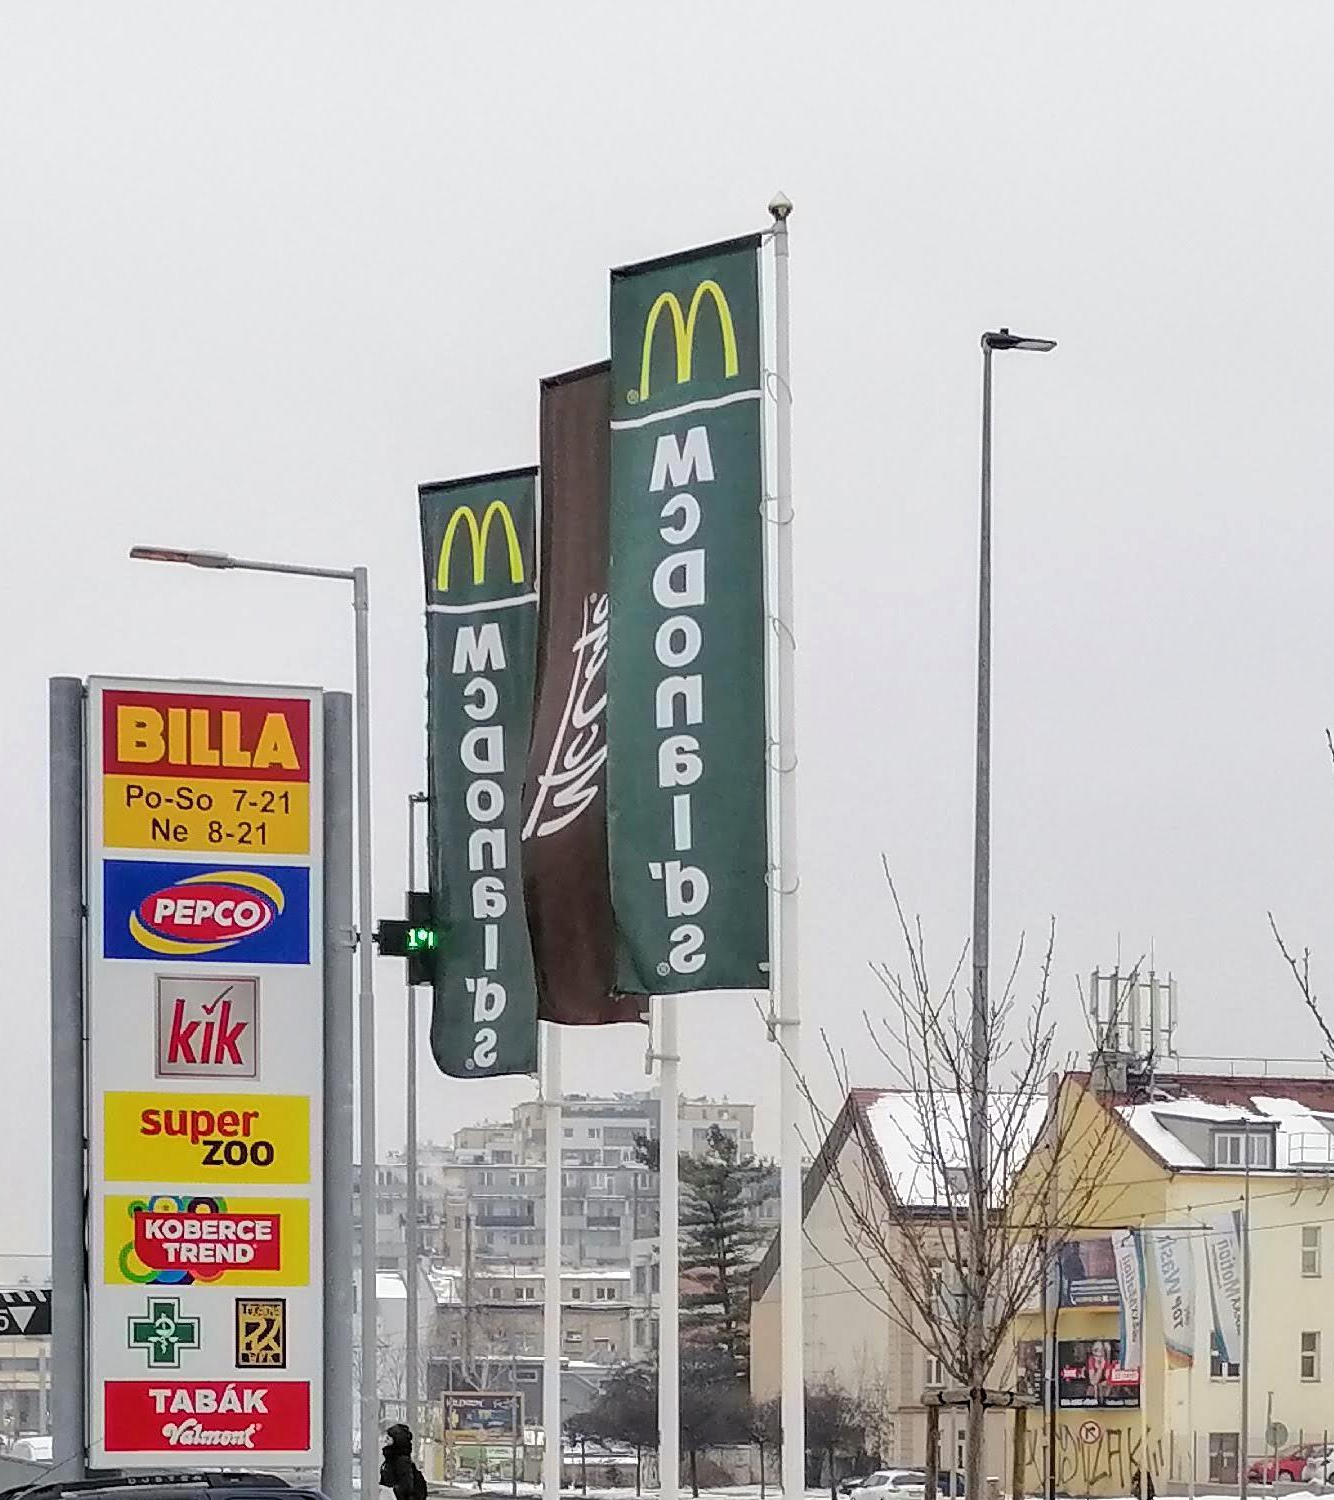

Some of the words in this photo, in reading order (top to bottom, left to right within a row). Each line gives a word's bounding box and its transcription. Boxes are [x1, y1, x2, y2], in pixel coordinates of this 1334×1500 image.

[116, 704, 301, 771] BILLA
[125, 784, 214, 812] Po-So
[231, 789, 291, 814] 7-21
[150, 818, 188, 842] Ne
[207, 820, 267, 846] 8-21
[153, 898, 261, 928] PEPCO
[167, 995, 248, 1065] kik
[140, 1108, 259, 1143] super
[201, 1139, 275, 1167] zoo
[144, 1218, 272, 1241] KOBERCE
[161, 1241, 254, 1264] TREND
[148, 1383, 268, 1415] TABÁK
[161, 1417, 258, 1448] Valmont
